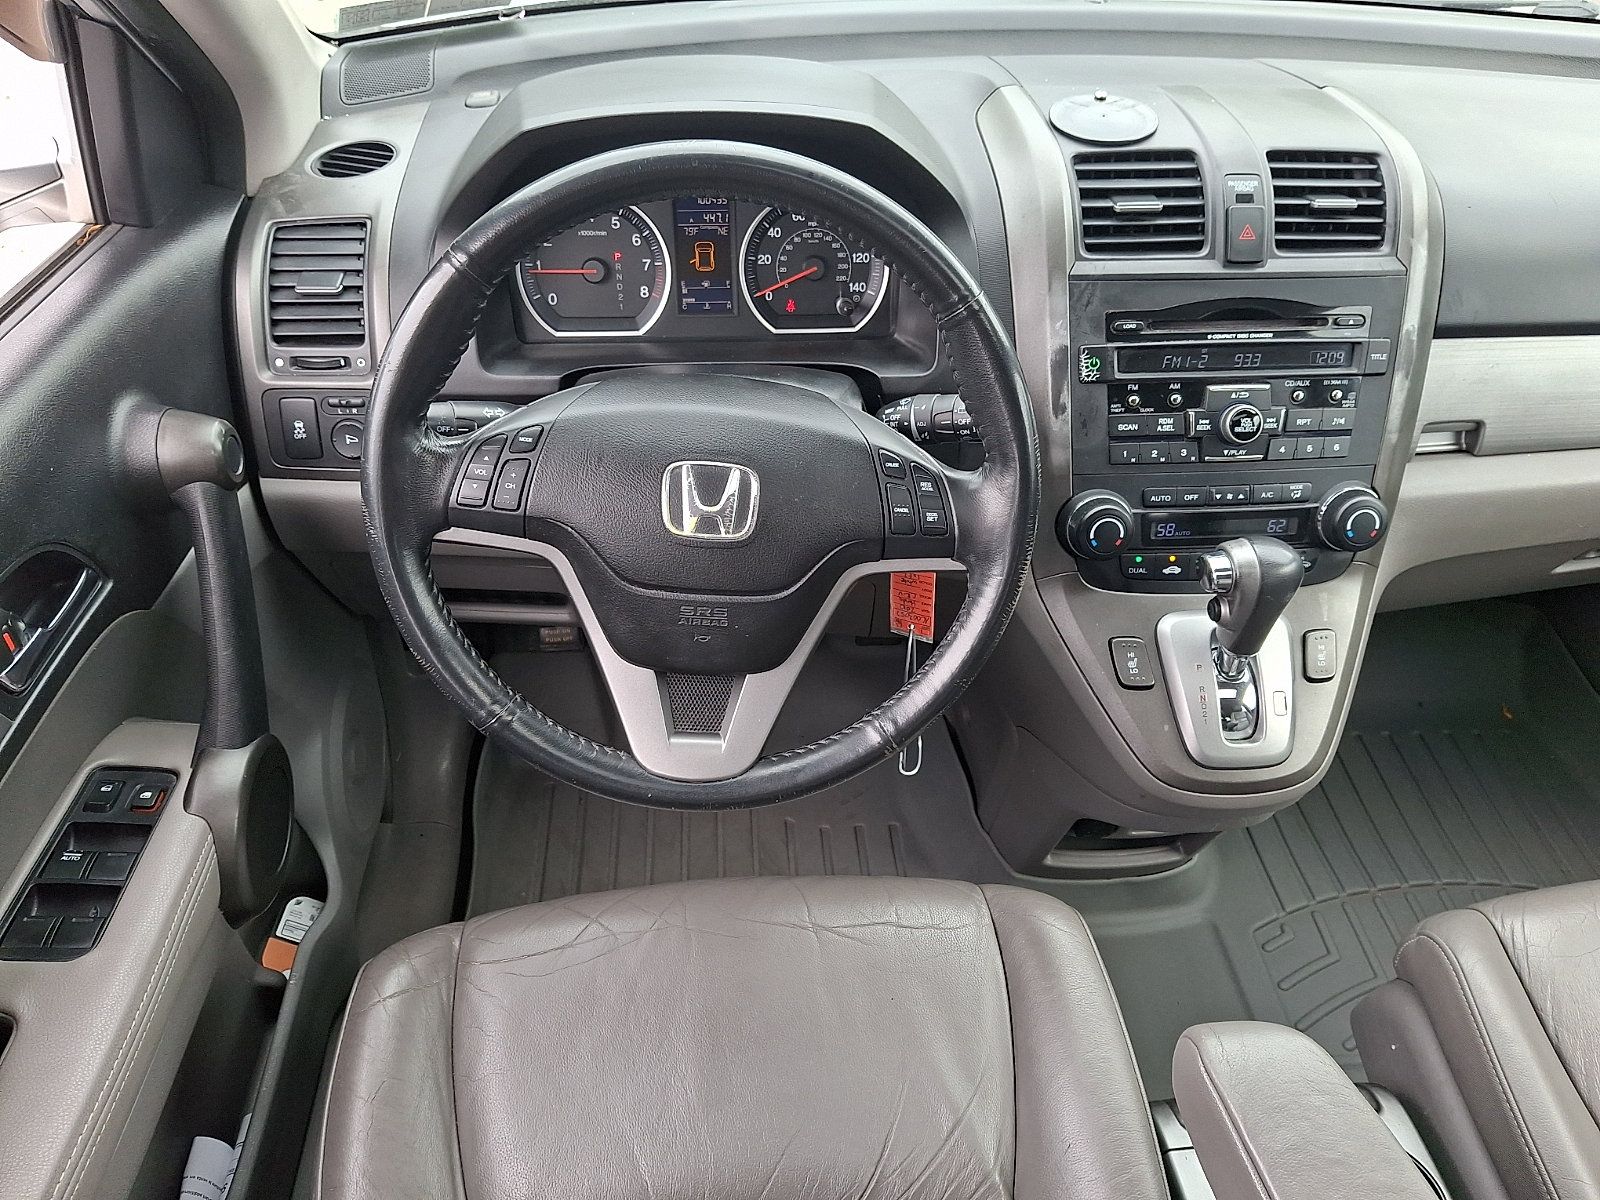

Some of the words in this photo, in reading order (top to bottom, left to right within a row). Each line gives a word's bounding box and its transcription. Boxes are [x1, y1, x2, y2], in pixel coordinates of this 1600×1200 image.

[611, 216, 621, 230] 5
[767, 227, 782, 238] 40
[631, 233, 642, 247] 6
[614, 252, 621, 260] P
[757, 254, 772, 265] 20
[852, 252, 870, 264] 120
[615, 263, 622, 271] R
[642, 259, 651, 271] 7
[616, 283, 624, 291] D
[848, 282, 867, 293] 140
[639, 285, 650, 299] 8
[765, 291, 773, 301] 0
[547, 293, 558, 306] 0
[1296, 418, 1312, 426] RPT
[437, 425, 450, 433] OFF
[1117, 423, 1139, 431] SCAN
[1279, 445, 1286, 453] 4
[1306, 444, 1313, 453] 5
[1333, 443, 1340, 451] 6
[1122, 450, 1128, 458] 1
[1151, 449, 1158, 458] 2
[1180, 448, 1187, 457] 3
[474, 468, 487, 476] VOL
[1150, 494, 1171, 502] AUTO
[1156, 523, 1176, 537] 58
[1267, 519, 1286, 533] 62
[680, 605, 728, 617] SRS
[678, 617, 728, 627] AIRBAG
[1199, 685, 1206, 693] R
[1200, 694, 1206, 702] N
